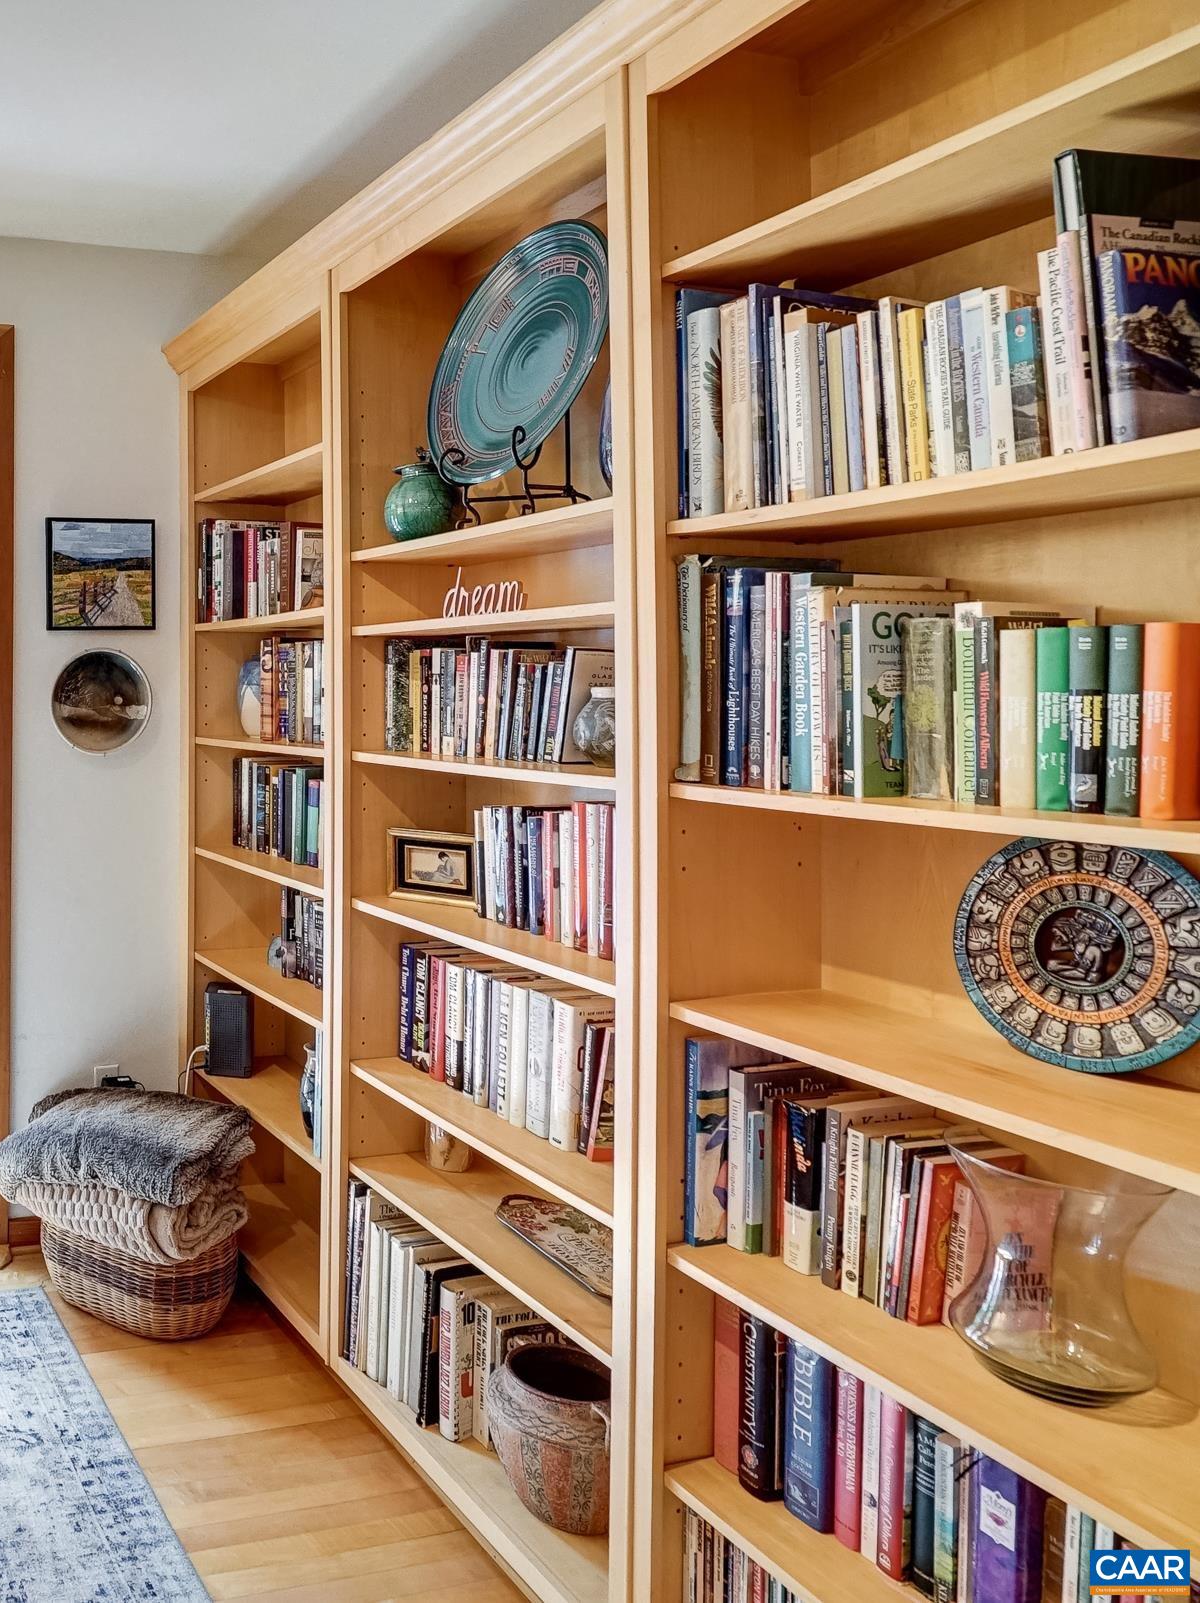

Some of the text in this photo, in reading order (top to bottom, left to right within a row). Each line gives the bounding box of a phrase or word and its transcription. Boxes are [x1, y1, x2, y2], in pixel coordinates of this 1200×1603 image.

[1100, 226, 1170, 242] The Canadian
[935, 304, 943, 319] THE
[1047, 250, 1066, 365] the Pacific Crest Trail
[793, 333, 801, 369] VIRGINIA
[936, 319, 945, 356] CANADIAN
[690, 346, 702, 390] NORTH
[738, 357, 746, 403] AUDUBON
[940, 357, 948, 386] ROCKIES
[907, 380, 919, 428] State Parks
[969, 351, 987, 438] Western Canada
[690, 392, 702, 451] AMERICAN
[943, 409, 951, 431] GUIDE
[691, 453, 703, 486] BIRDS
[443, 566, 524, 619] dream
[704, 583, 717, 670] Wild Animals
[727, 624, 737, 637] The
[519, 653, 534, 663] The
[728, 638, 737, 664] Ultimate
[794, 595, 809, 737] Western Garden Book
[868, 644, 885, 654] IT'S
[728, 665, 737, 677] Book
[750, 602, 761, 760] AMERICA'S BEST DAY HIKES
[979, 670, 990, 691] Wild
[727, 690, 740, 751] Lighthouses
[979, 692, 990, 726] Flowers
[980, 736, 990, 770] Alberta
[402, 948, 410, 965] Tom
[399, 966, 410, 994] Clancy
[414, 958, 426, 1020] TOM CLANCY
[400, 995, 409, 1016] Debt
[448, 971, 458, 1033] TOM CLANCY
[400, 1025, 410, 1052] Honor
[417, 1022, 425, 1035] DEAD
[497, 1012, 509, 1101] KEN FOLLETT
[731, 1099, 742, 1121] Tina
[828, 1126, 838, 1154] Knight
[828, 1156, 837, 1191] Fulfilled
[850, 1142, 860, 1200] FANNIE FLAGG
[380, 1204, 396, 1214] The
[825, 1215, 835, 1240] Penny
[825, 1241, 835, 1270] Knight
[495, 1314, 514, 1326] THE
[440, 1308, 452, 1420] 1002 JUMBO JAZZ ALBUM
[742, 1321, 757, 1432] CHRISTIANITY
[793, 1355, 813, 1447] BIBLE
[847, 1376, 857, 1423] GODDESSES
[846, 1434, 857, 1494] EVERYWOMAN
[881, 1454, 894, 1500] Company
[881, 1518, 893, 1552] Others
